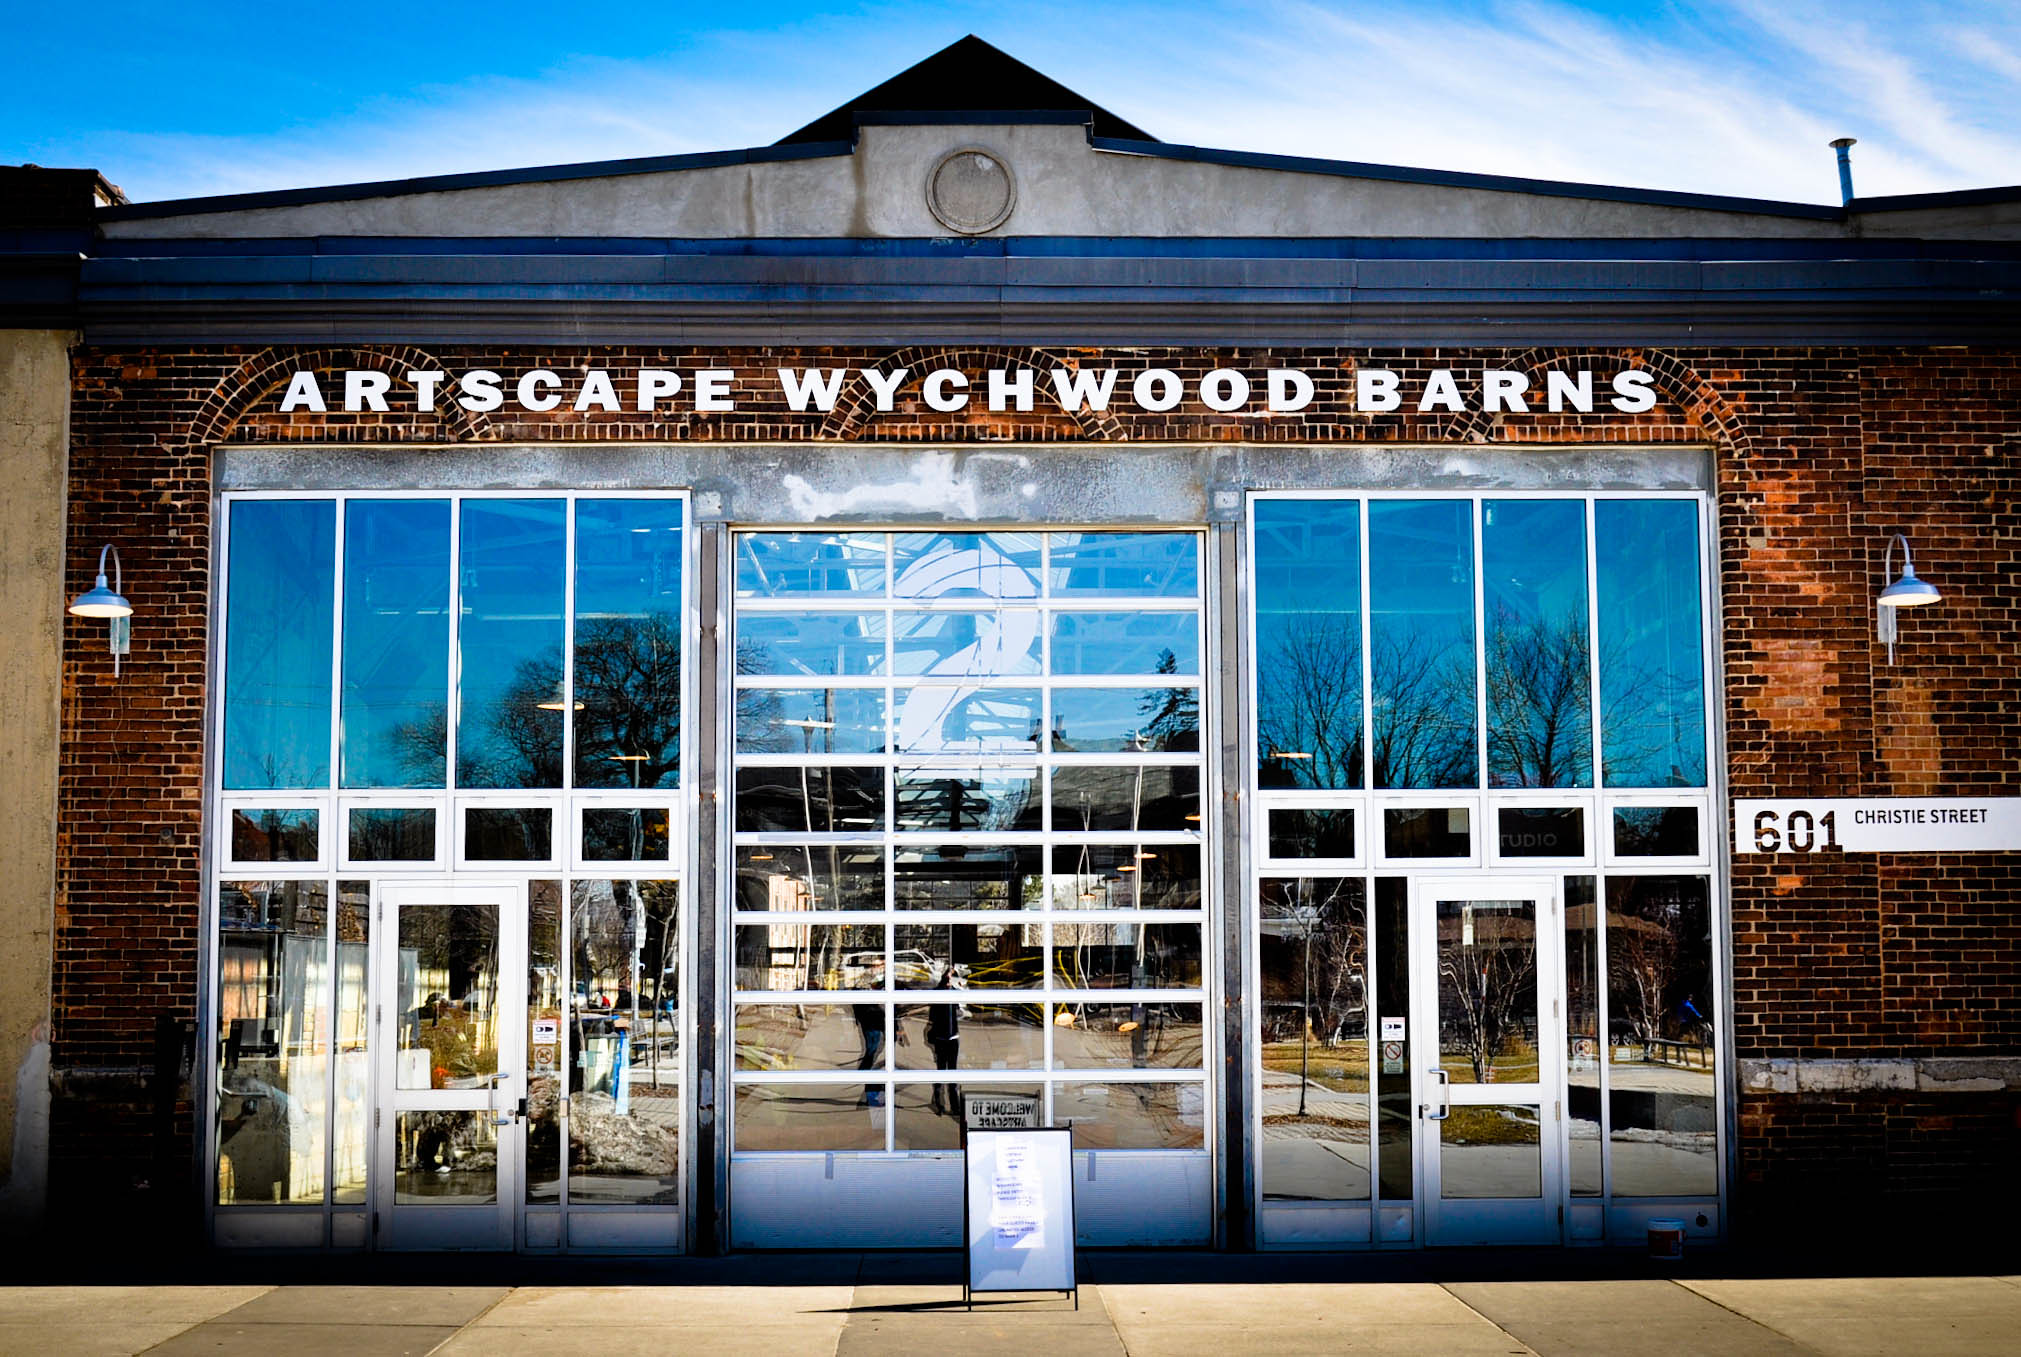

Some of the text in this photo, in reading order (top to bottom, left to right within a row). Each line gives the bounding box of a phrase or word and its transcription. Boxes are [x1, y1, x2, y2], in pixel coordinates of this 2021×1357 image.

[280, 368, 1657, 413] ARTSCAPE WYCHWOOD BARNS
[1500, 832, 1558, 848] TUDIO
[1753, 808, 1988, 853] 601 CHRISTIE STREET
